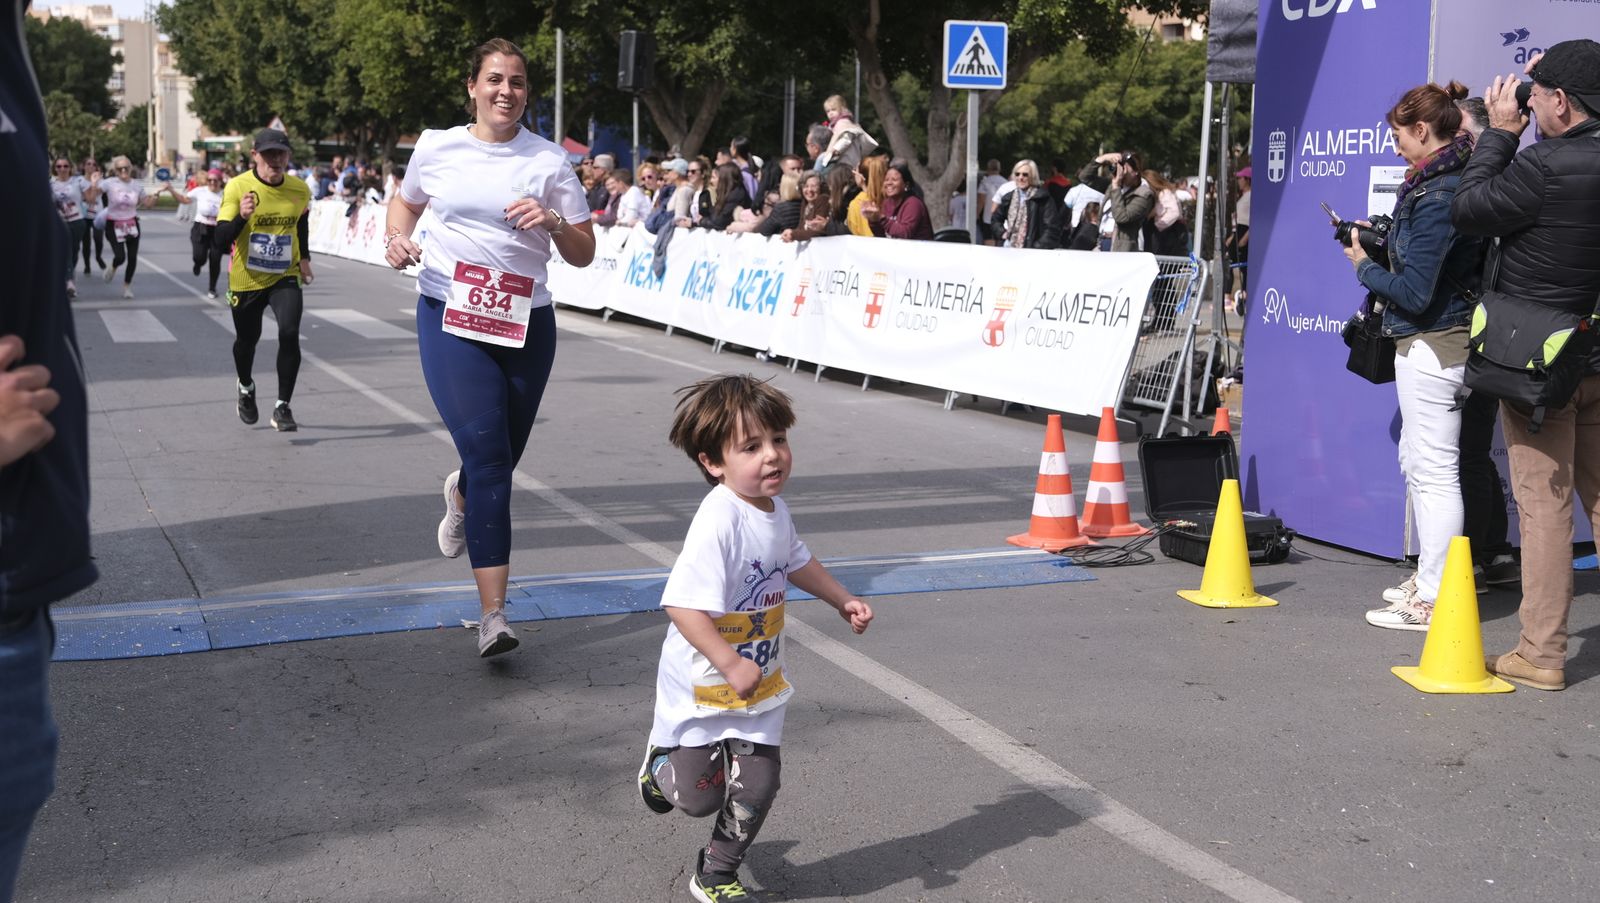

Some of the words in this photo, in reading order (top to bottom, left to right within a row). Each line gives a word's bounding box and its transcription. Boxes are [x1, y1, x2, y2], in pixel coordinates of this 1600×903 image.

[1301, 121, 1397, 156] ALMERÍA
[1300, 160, 1346, 177] CIUDAD
[260, 244, 284, 257] 382
[468, 286, 513, 313] 634
[901, 277, 984, 314] ALMERÍA
[1028, 288, 1131, 328] ALMERÍA
[462, 303, 482, 313] MARIA
[485, 307, 513, 319] ANGELES
[896, 311, 938, 333] CIUDAD
[1025, 326, 1074, 350] CIUDAD
[736, 632, 781, 667] 584
